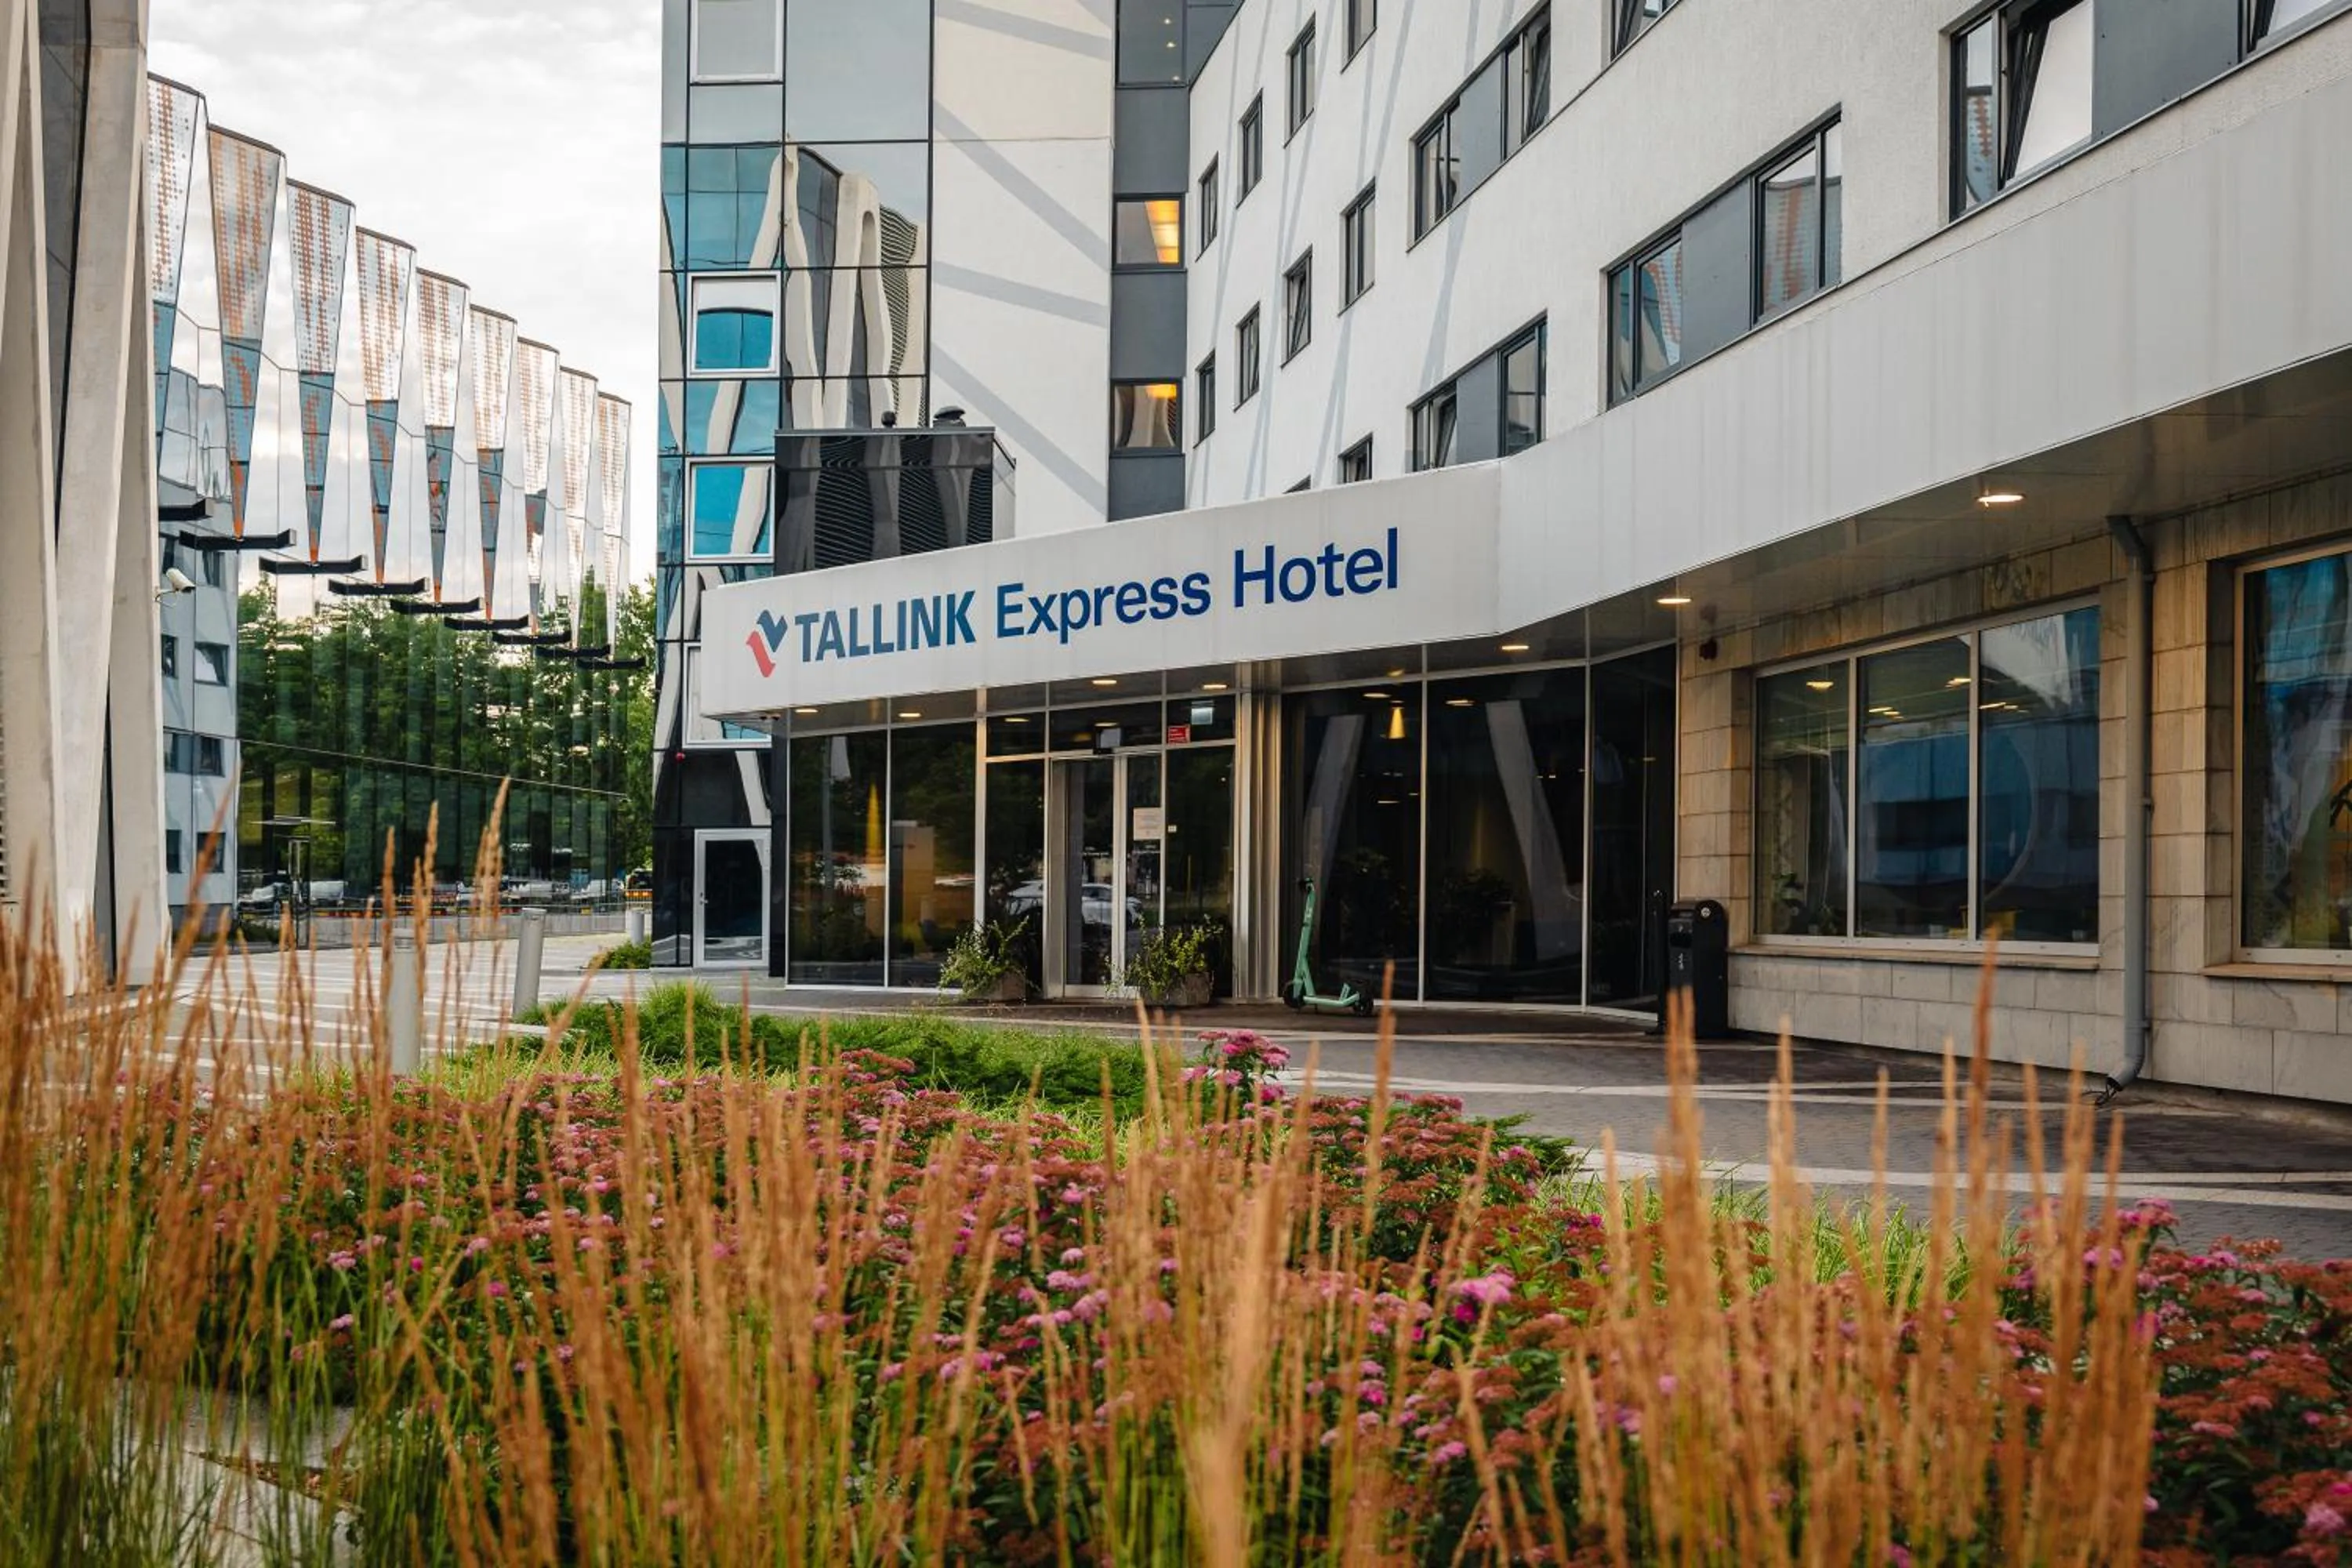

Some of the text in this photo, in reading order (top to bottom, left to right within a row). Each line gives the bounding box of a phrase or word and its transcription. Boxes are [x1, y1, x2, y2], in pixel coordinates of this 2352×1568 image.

[794, 526, 1399, 663] TALLINK Express Hotel
